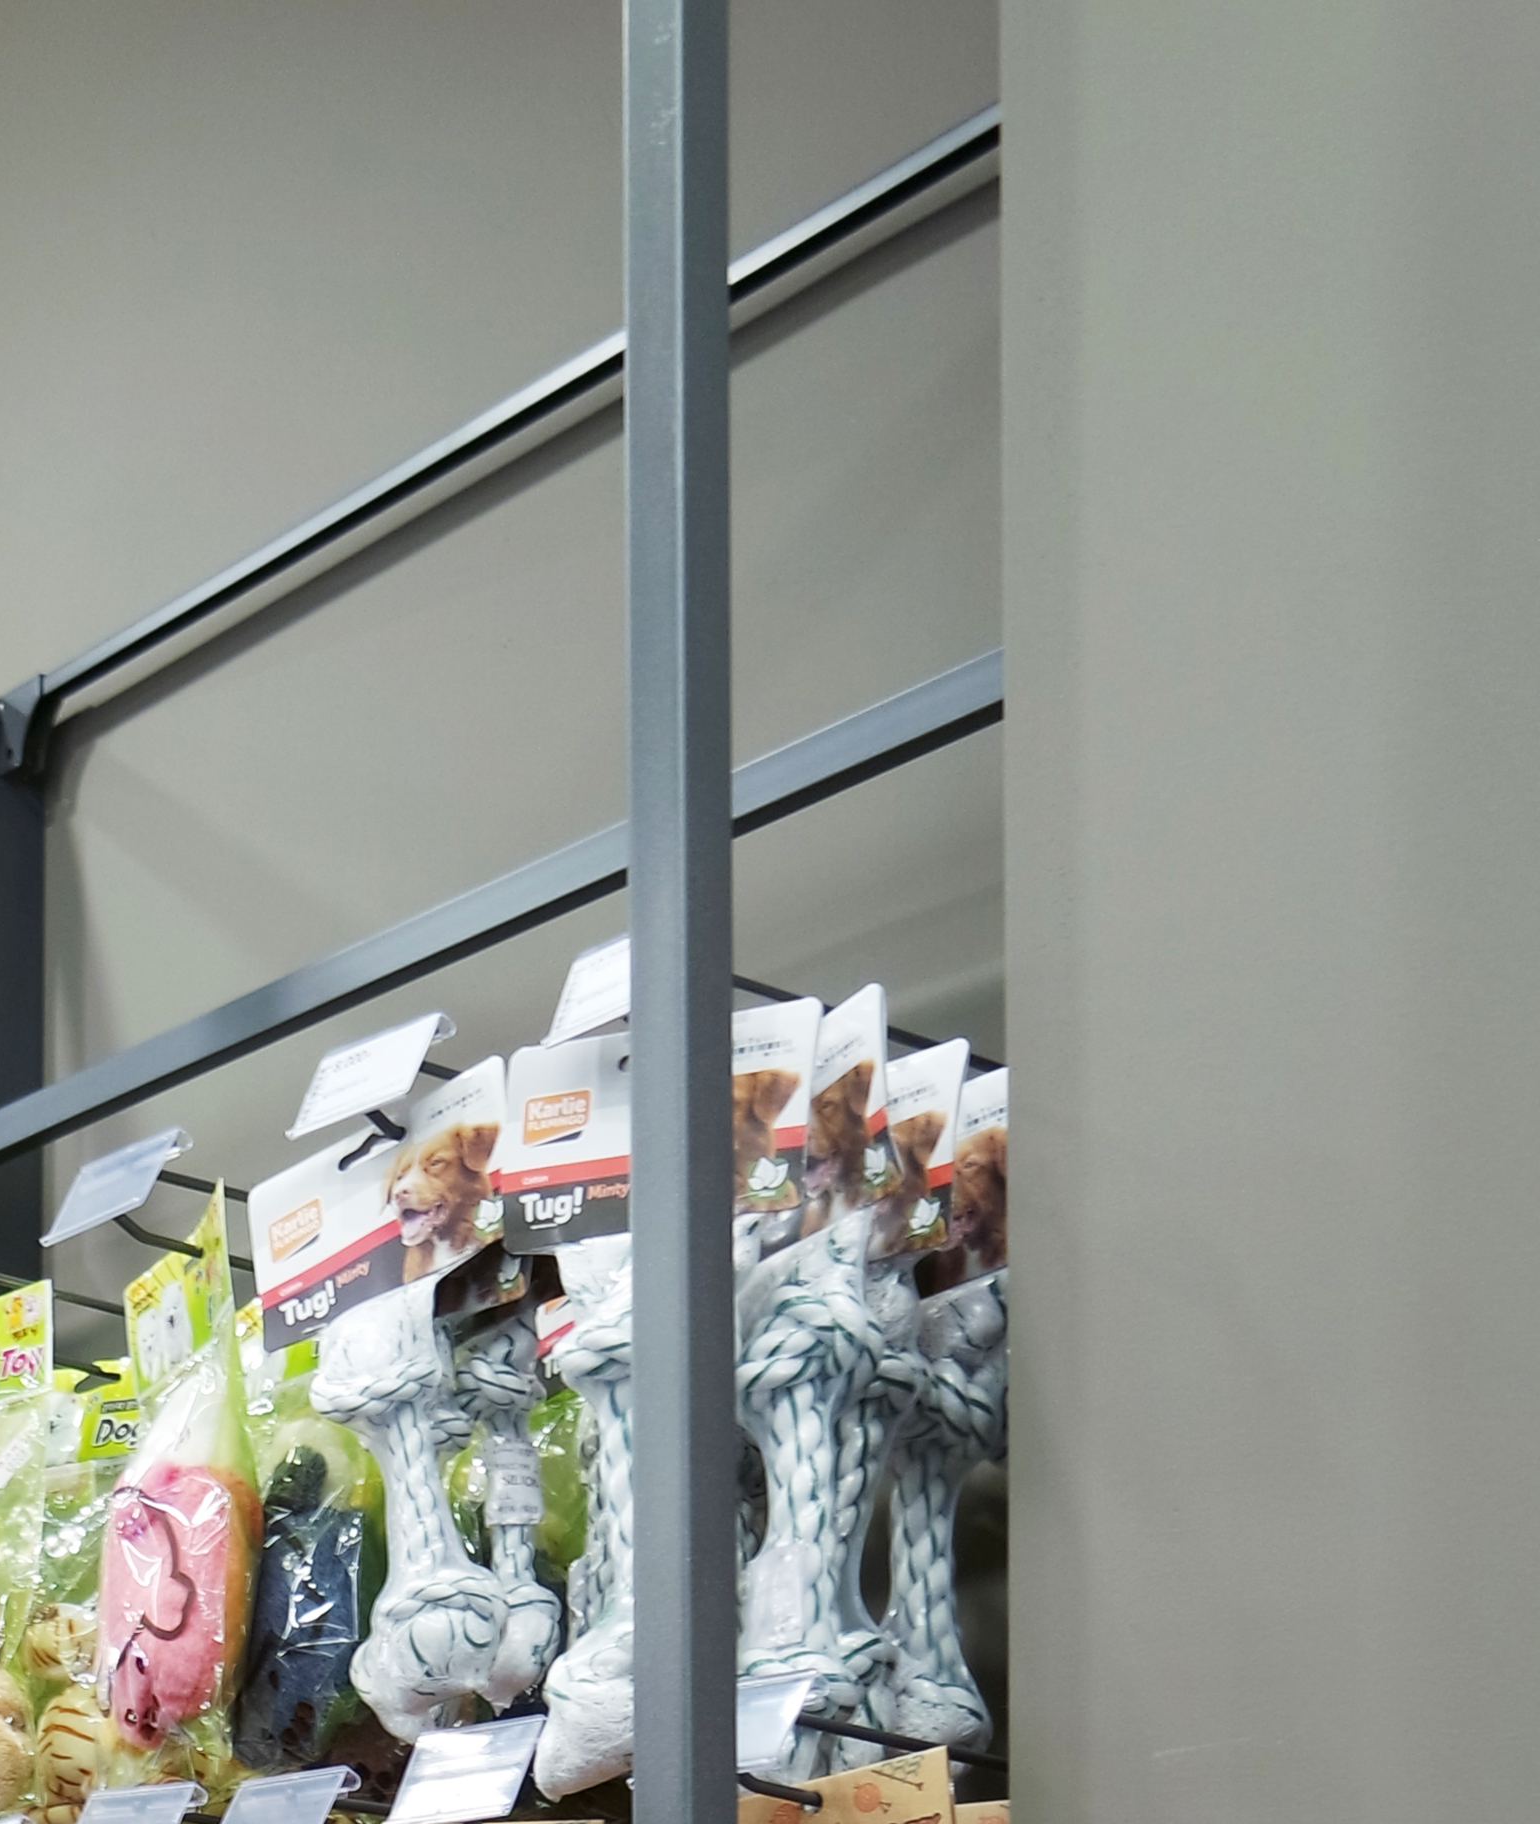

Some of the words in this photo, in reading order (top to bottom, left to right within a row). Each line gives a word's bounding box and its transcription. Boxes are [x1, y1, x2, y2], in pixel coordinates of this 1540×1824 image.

[527, 1096, 587, 1121] Karlie
[519, 1186, 584, 1225] Tug!
[278, 1279, 336, 1326] Tug!
